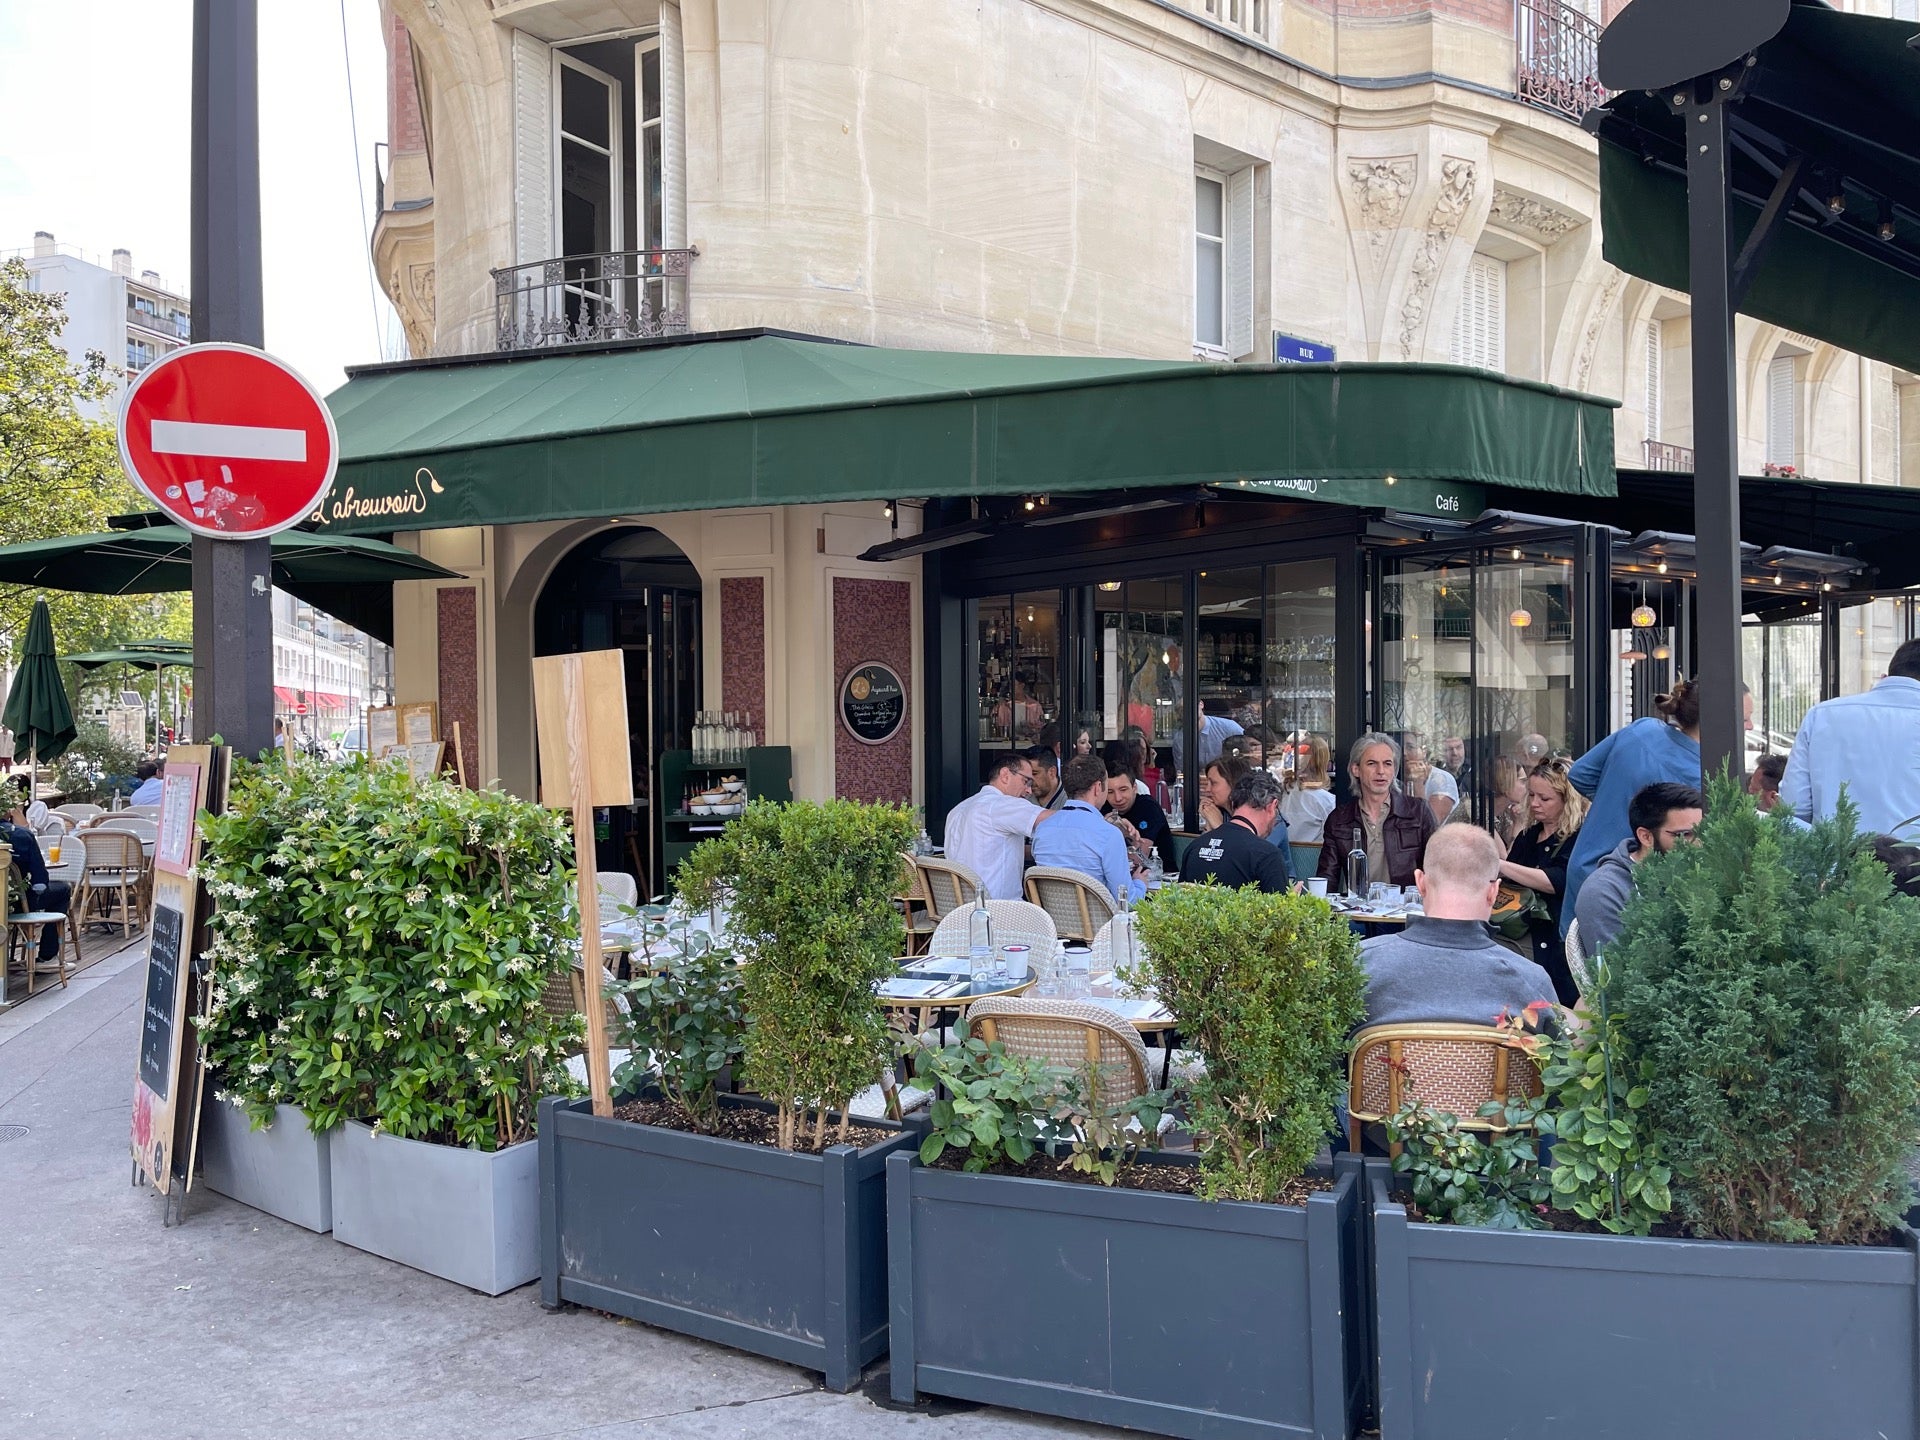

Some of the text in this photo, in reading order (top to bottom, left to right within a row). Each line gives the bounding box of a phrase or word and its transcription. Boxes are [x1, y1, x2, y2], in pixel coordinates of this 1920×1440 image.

[1299, 347, 1314, 359] RUE
[311, 475, 430, 525] L'abreuvoir
[1435, 494, 1459, 512] Café
